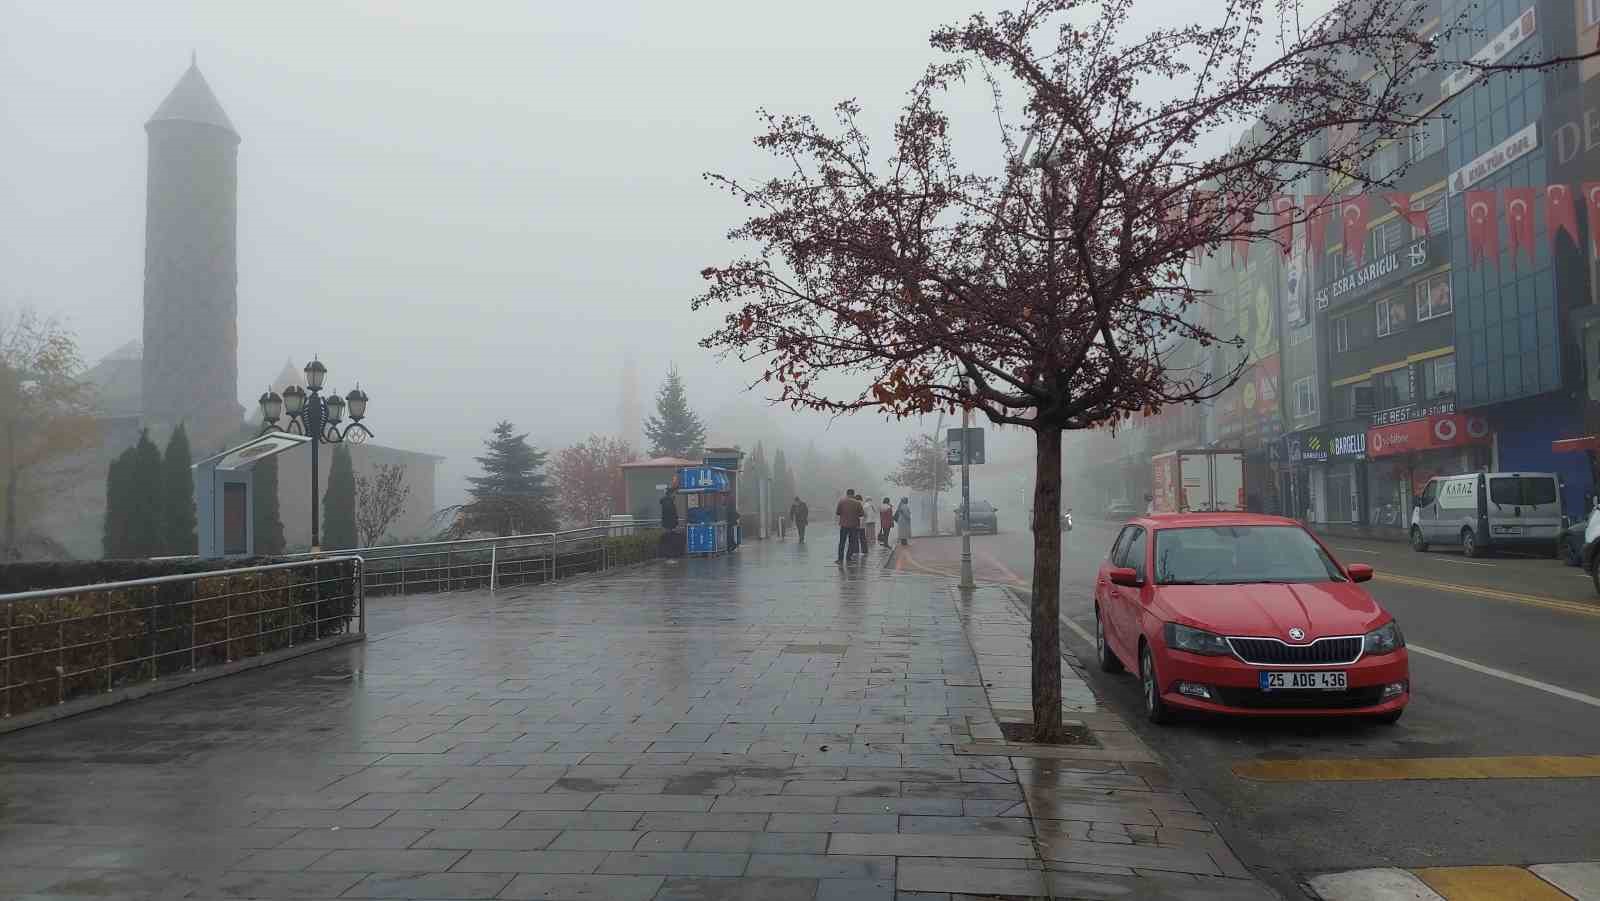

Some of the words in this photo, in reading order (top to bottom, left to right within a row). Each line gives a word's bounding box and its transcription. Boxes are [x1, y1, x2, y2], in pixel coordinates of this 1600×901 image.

[1332, 278, 1357, 297] ESRA
[1358, 253, 1400, 286] SARIGÜL
[1374, 411, 1388, 425] THE
[1390, 407, 1410, 422] BEST
[1335, 432, 1366, 456] BARGELLO
[1269, 673, 1285, 687] 25
[1321, 673, 1345, 687] 436
